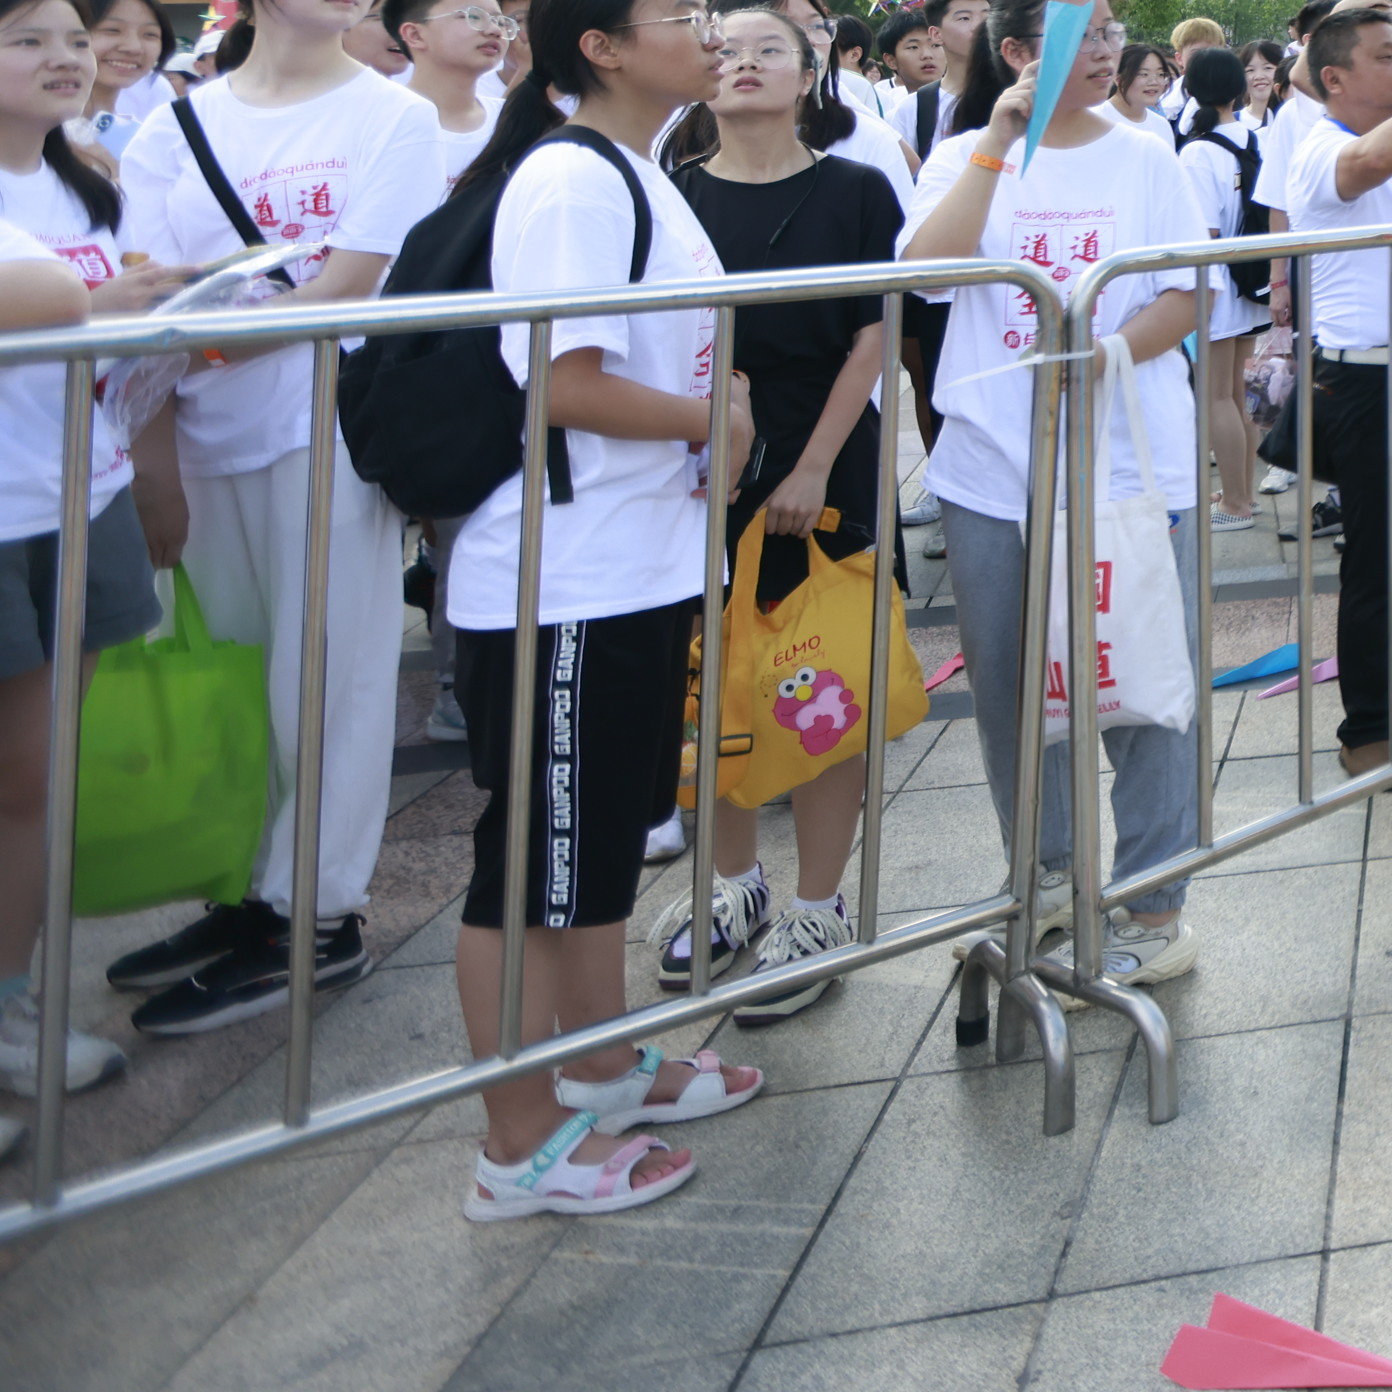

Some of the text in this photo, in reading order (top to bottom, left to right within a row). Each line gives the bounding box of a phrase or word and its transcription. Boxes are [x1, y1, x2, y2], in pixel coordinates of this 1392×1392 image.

[556, 621, 578, 683] GANPO
[774, 635, 821, 667] ELMO
[554, 689, 572, 756] GANPOO
[552, 762, 572, 831] GANPOO
[551, 837, 571, 906] GANPOO
